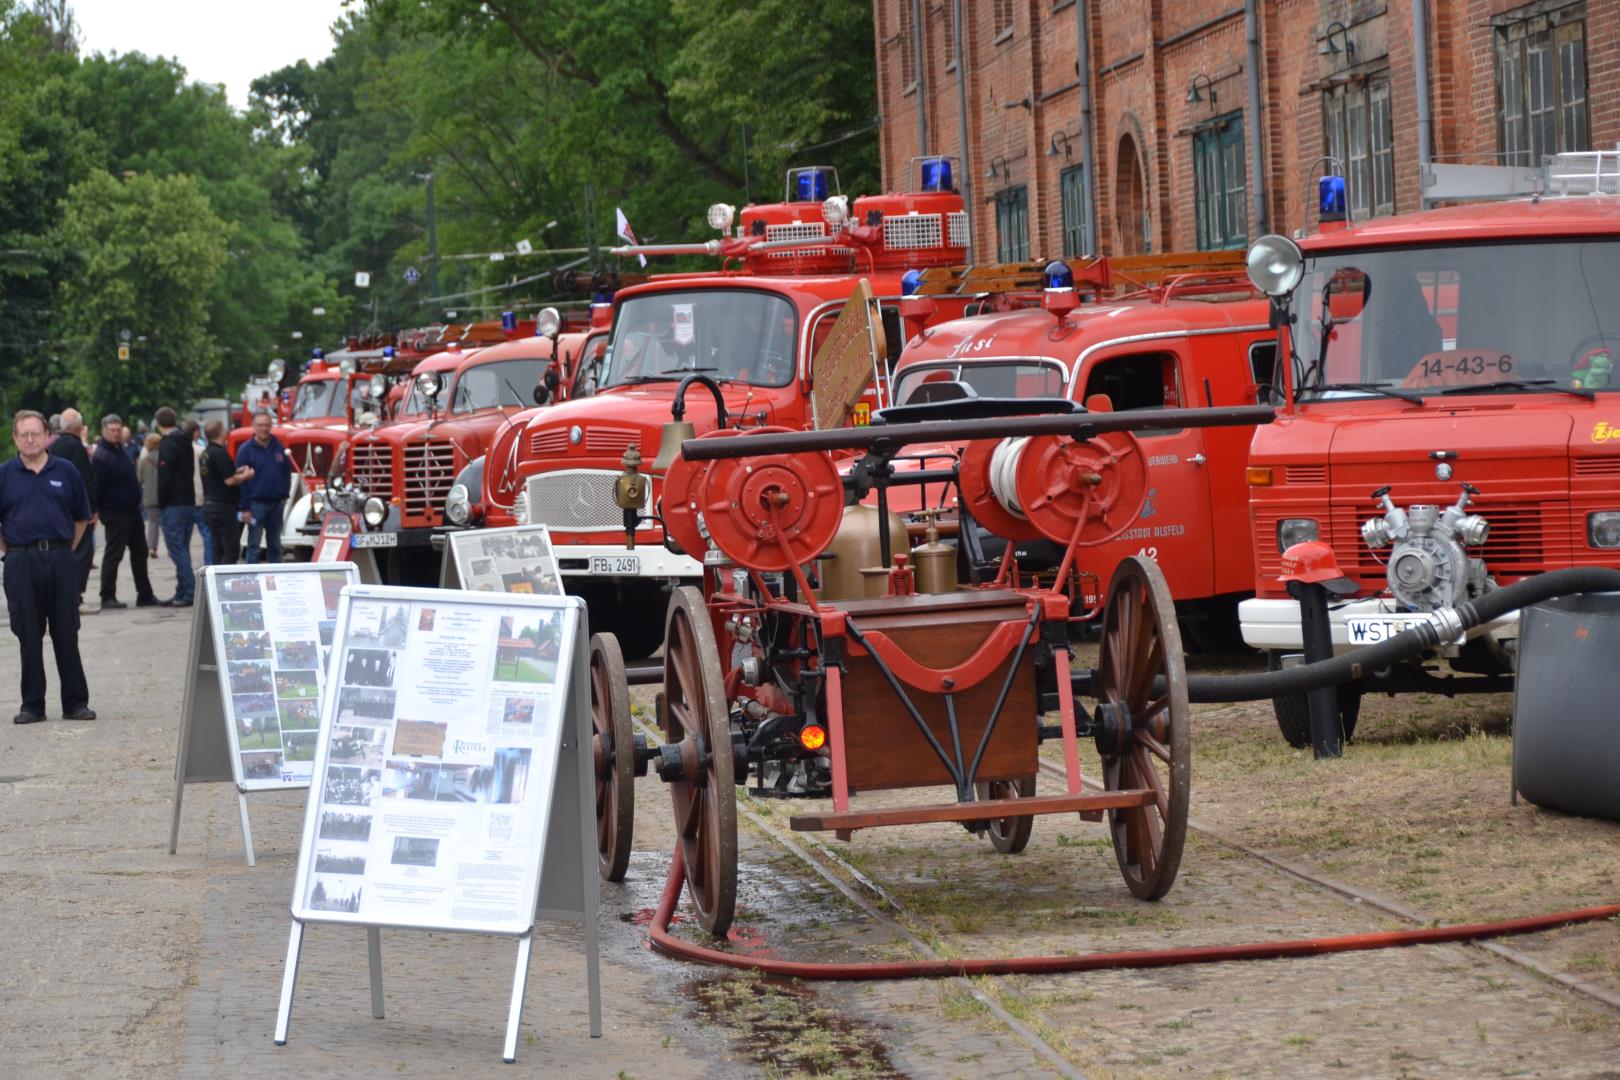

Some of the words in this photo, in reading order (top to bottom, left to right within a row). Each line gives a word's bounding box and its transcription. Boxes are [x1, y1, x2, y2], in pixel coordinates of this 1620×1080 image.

[1420, 354, 1513, 378] 14-43-6
[1154, 524, 1185, 537] ALSFELD
[594, 558, 608, 572] FB
[616, 558, 636, 572] 2491
